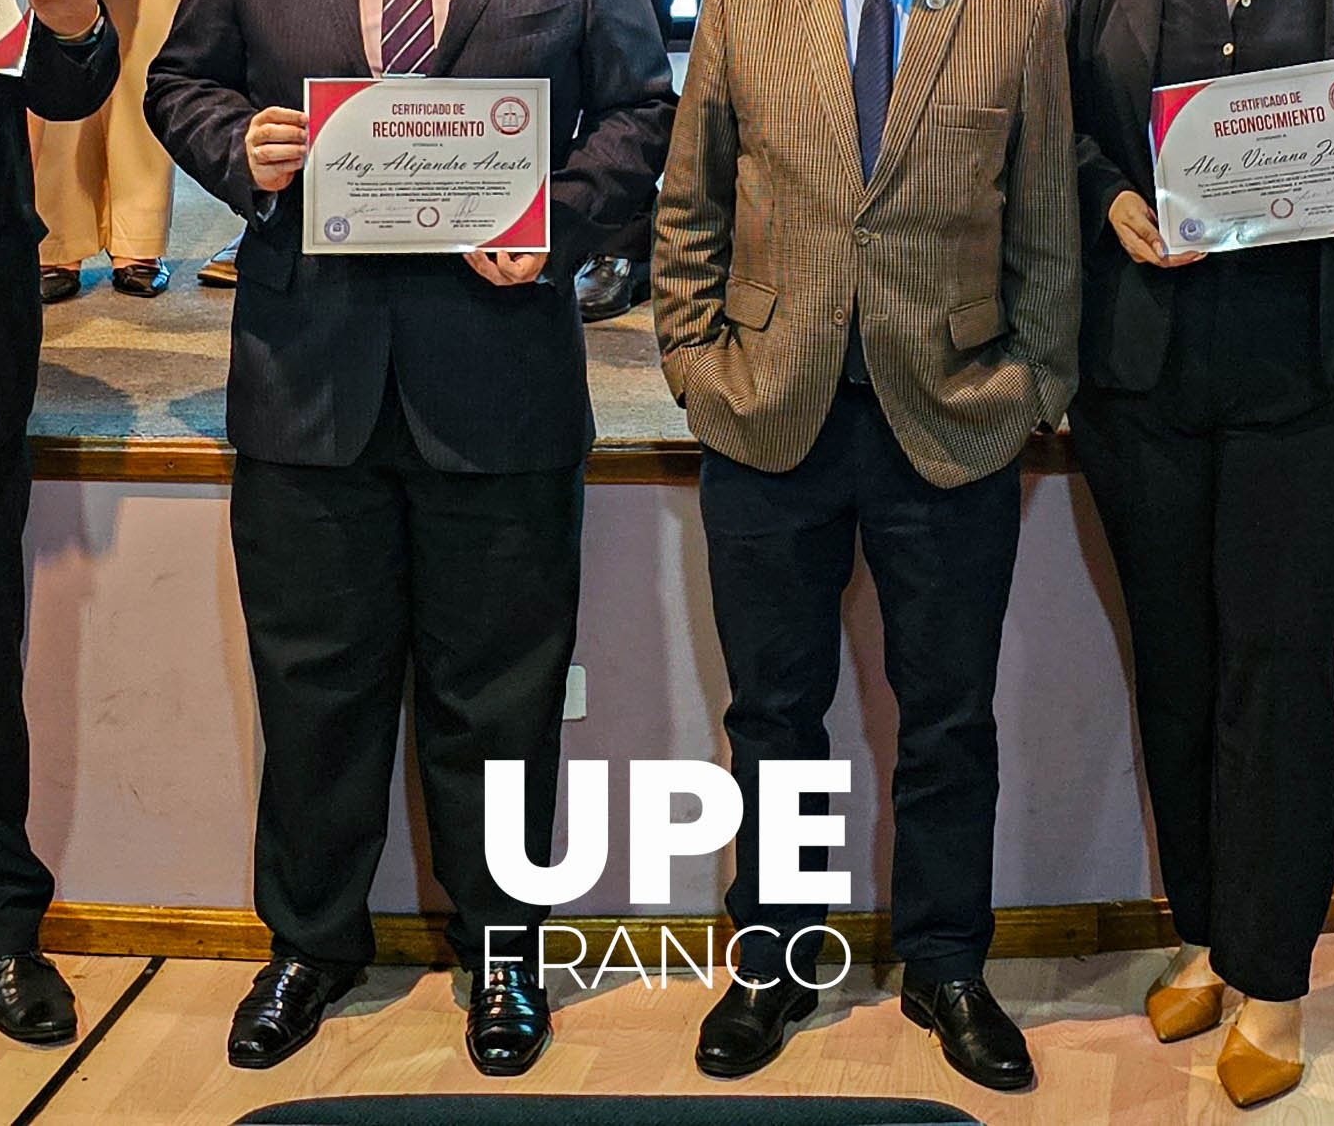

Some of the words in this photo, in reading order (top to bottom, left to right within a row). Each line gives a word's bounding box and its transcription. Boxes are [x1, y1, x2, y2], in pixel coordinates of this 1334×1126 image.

[392, 103, 451, 115] CERTIFICADO
[453, 104, 465, 115] DE
[1230, 94, 1288, 114] CERTIFICADO
[1290, 91, 1302, 103] DE
[372, 121, 485, 138] RECONOCIMIENTO
[1214, 106, 1325, 138] RECONOCIMIENTO
[382, 151, 467, 178] Alejandro
[473, 150, 531, 171] Acosta
[1241, 148, 1307, 170] Viviana
